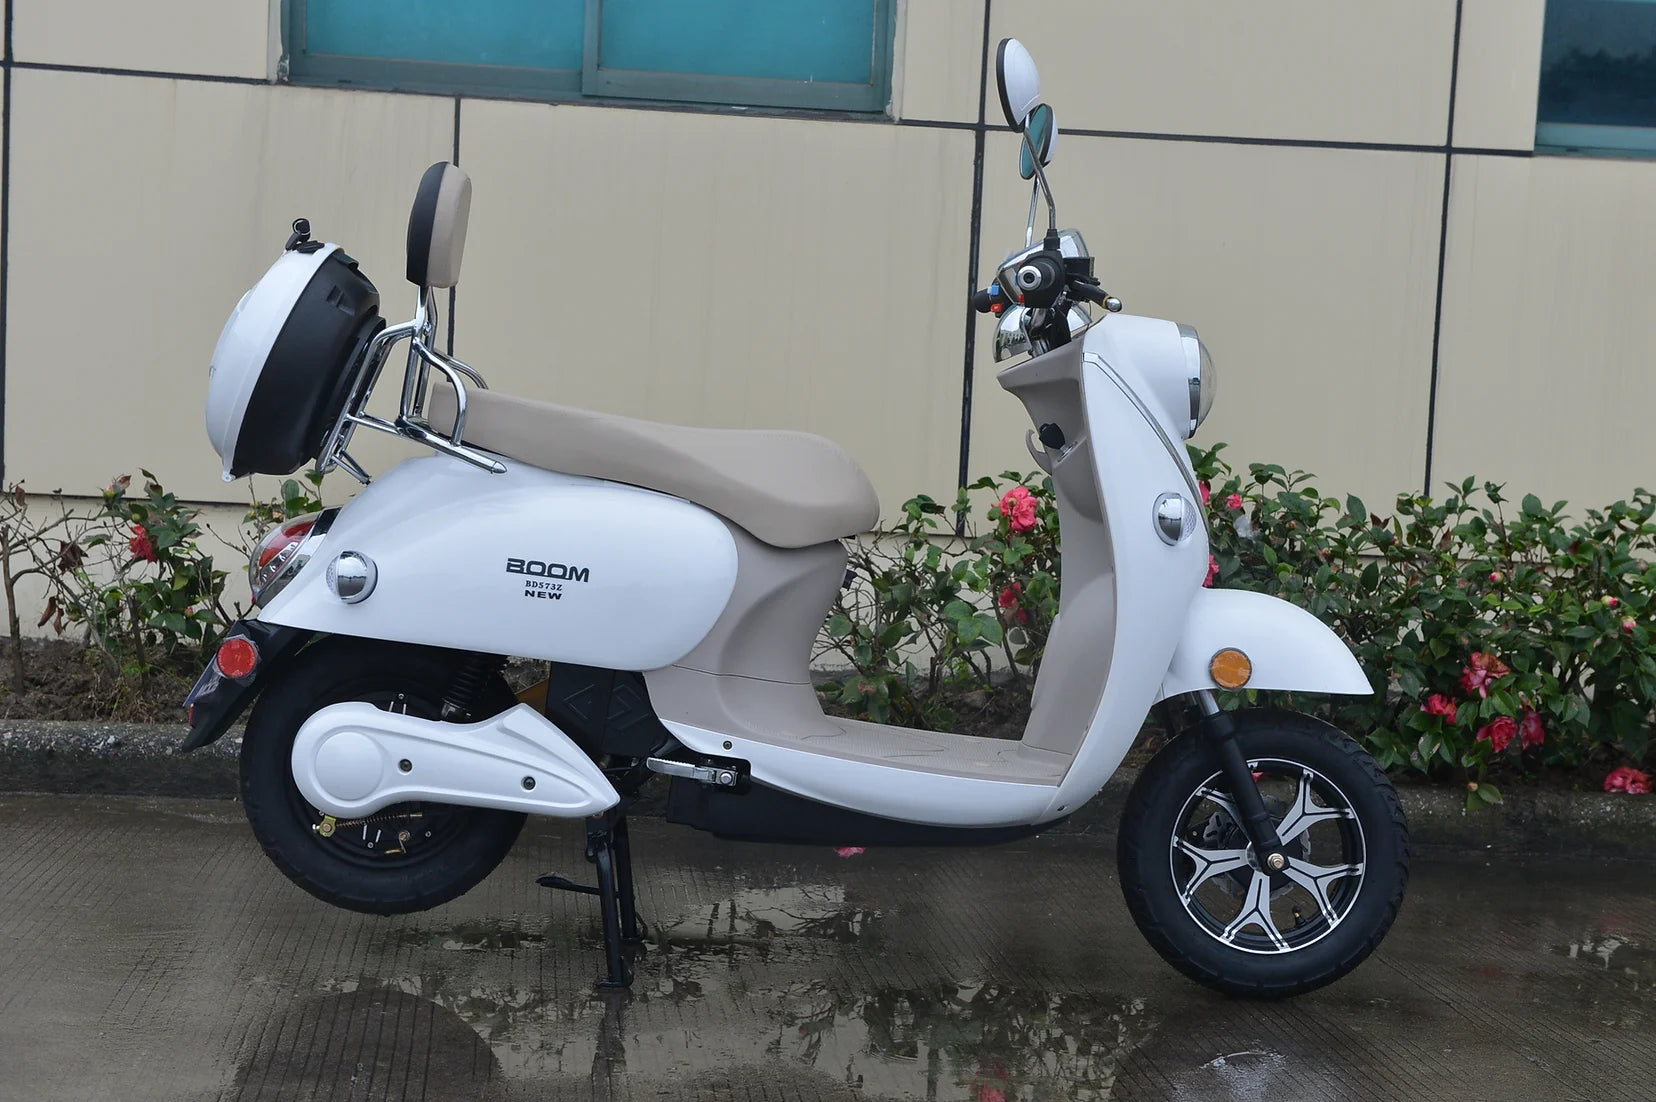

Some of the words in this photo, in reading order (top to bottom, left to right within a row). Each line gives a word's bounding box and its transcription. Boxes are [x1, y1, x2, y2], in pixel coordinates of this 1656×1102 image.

[506, 557, 590, 583] BOOM
[525, 580, 563, 591] BD573Z
[524, 589, 562, 600] NEW
